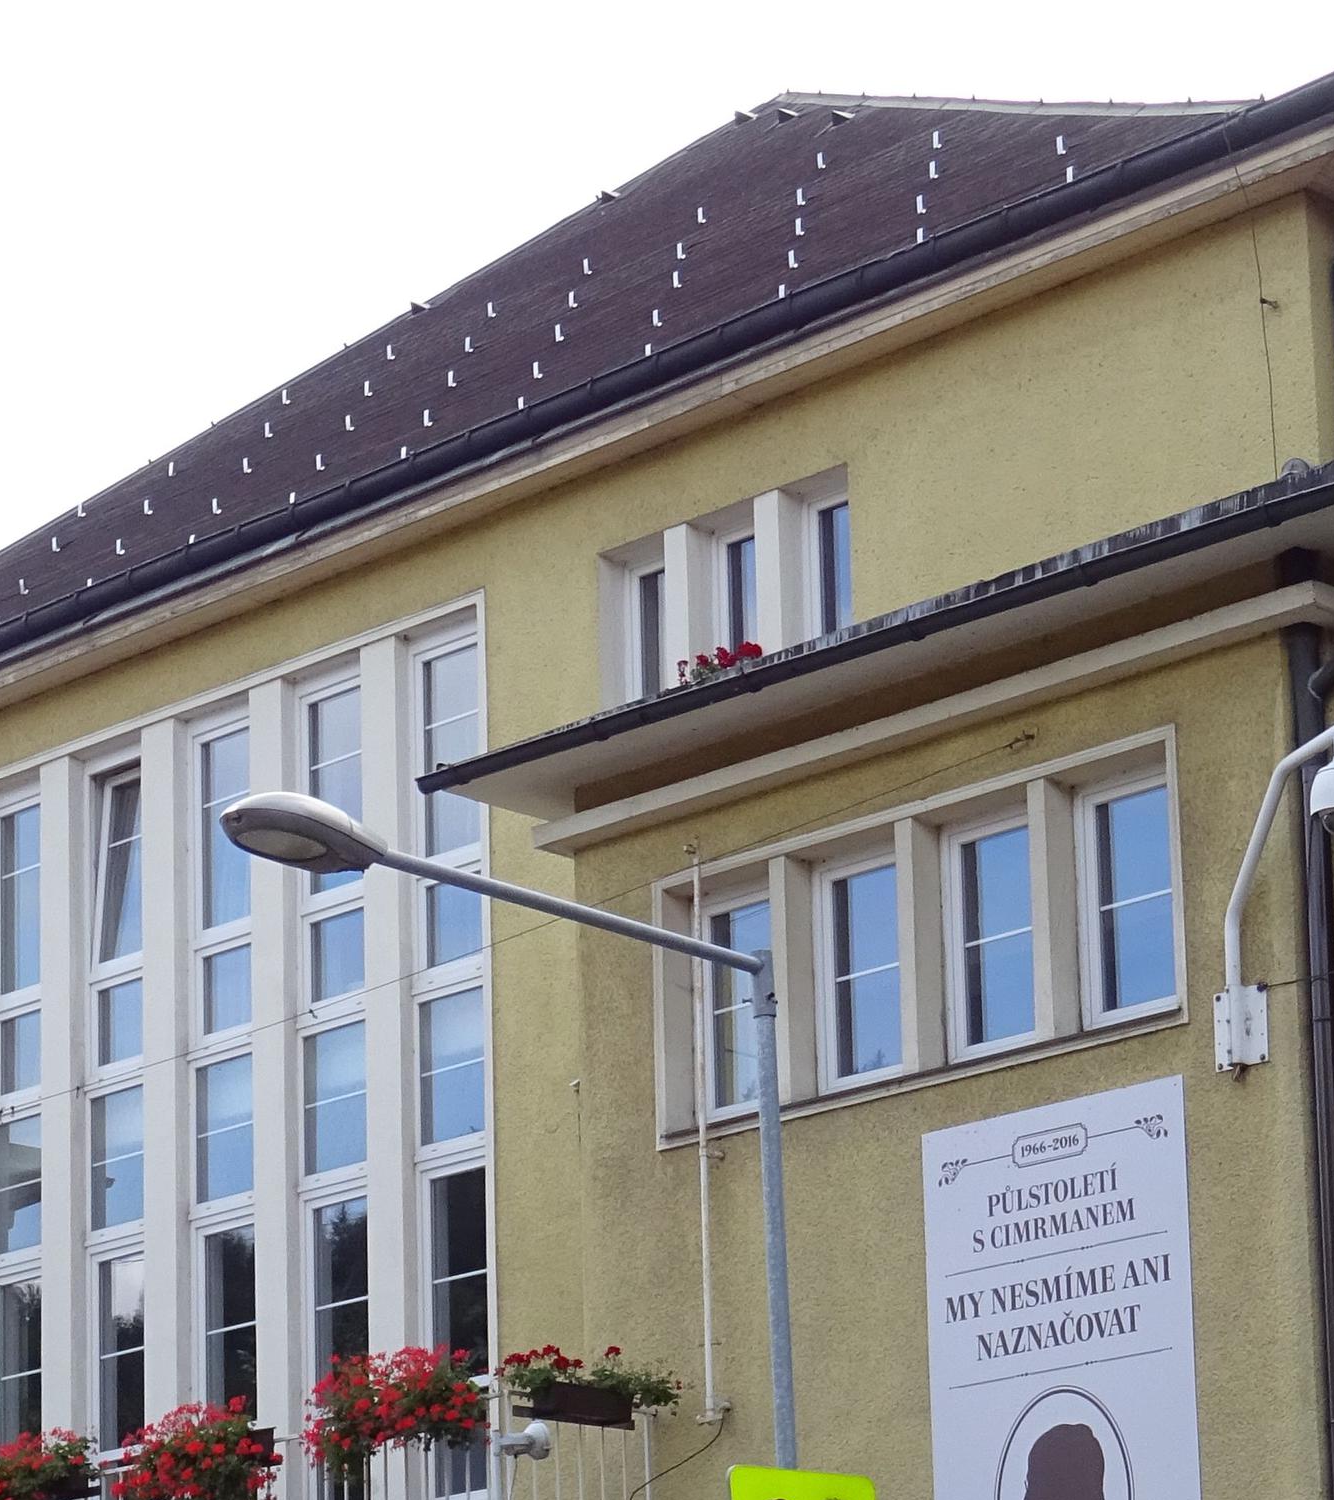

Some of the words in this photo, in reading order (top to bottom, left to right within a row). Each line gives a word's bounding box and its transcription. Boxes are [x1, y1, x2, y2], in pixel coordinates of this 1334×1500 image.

[987, 1162, 1118, 1217] PŮLSTOLETÍ
[972, 1229, 985, 1253] S
[990, 1197, 1136, 1250] CIMRMANEM
[945, 1291, 985, 1324] MY
[990, 1264, 1116, 1316] NESMÍME
[1122, 1253, 1172, 1290] ANI
[976, 1304, 1141, 1361] NAZNAČOVAT
